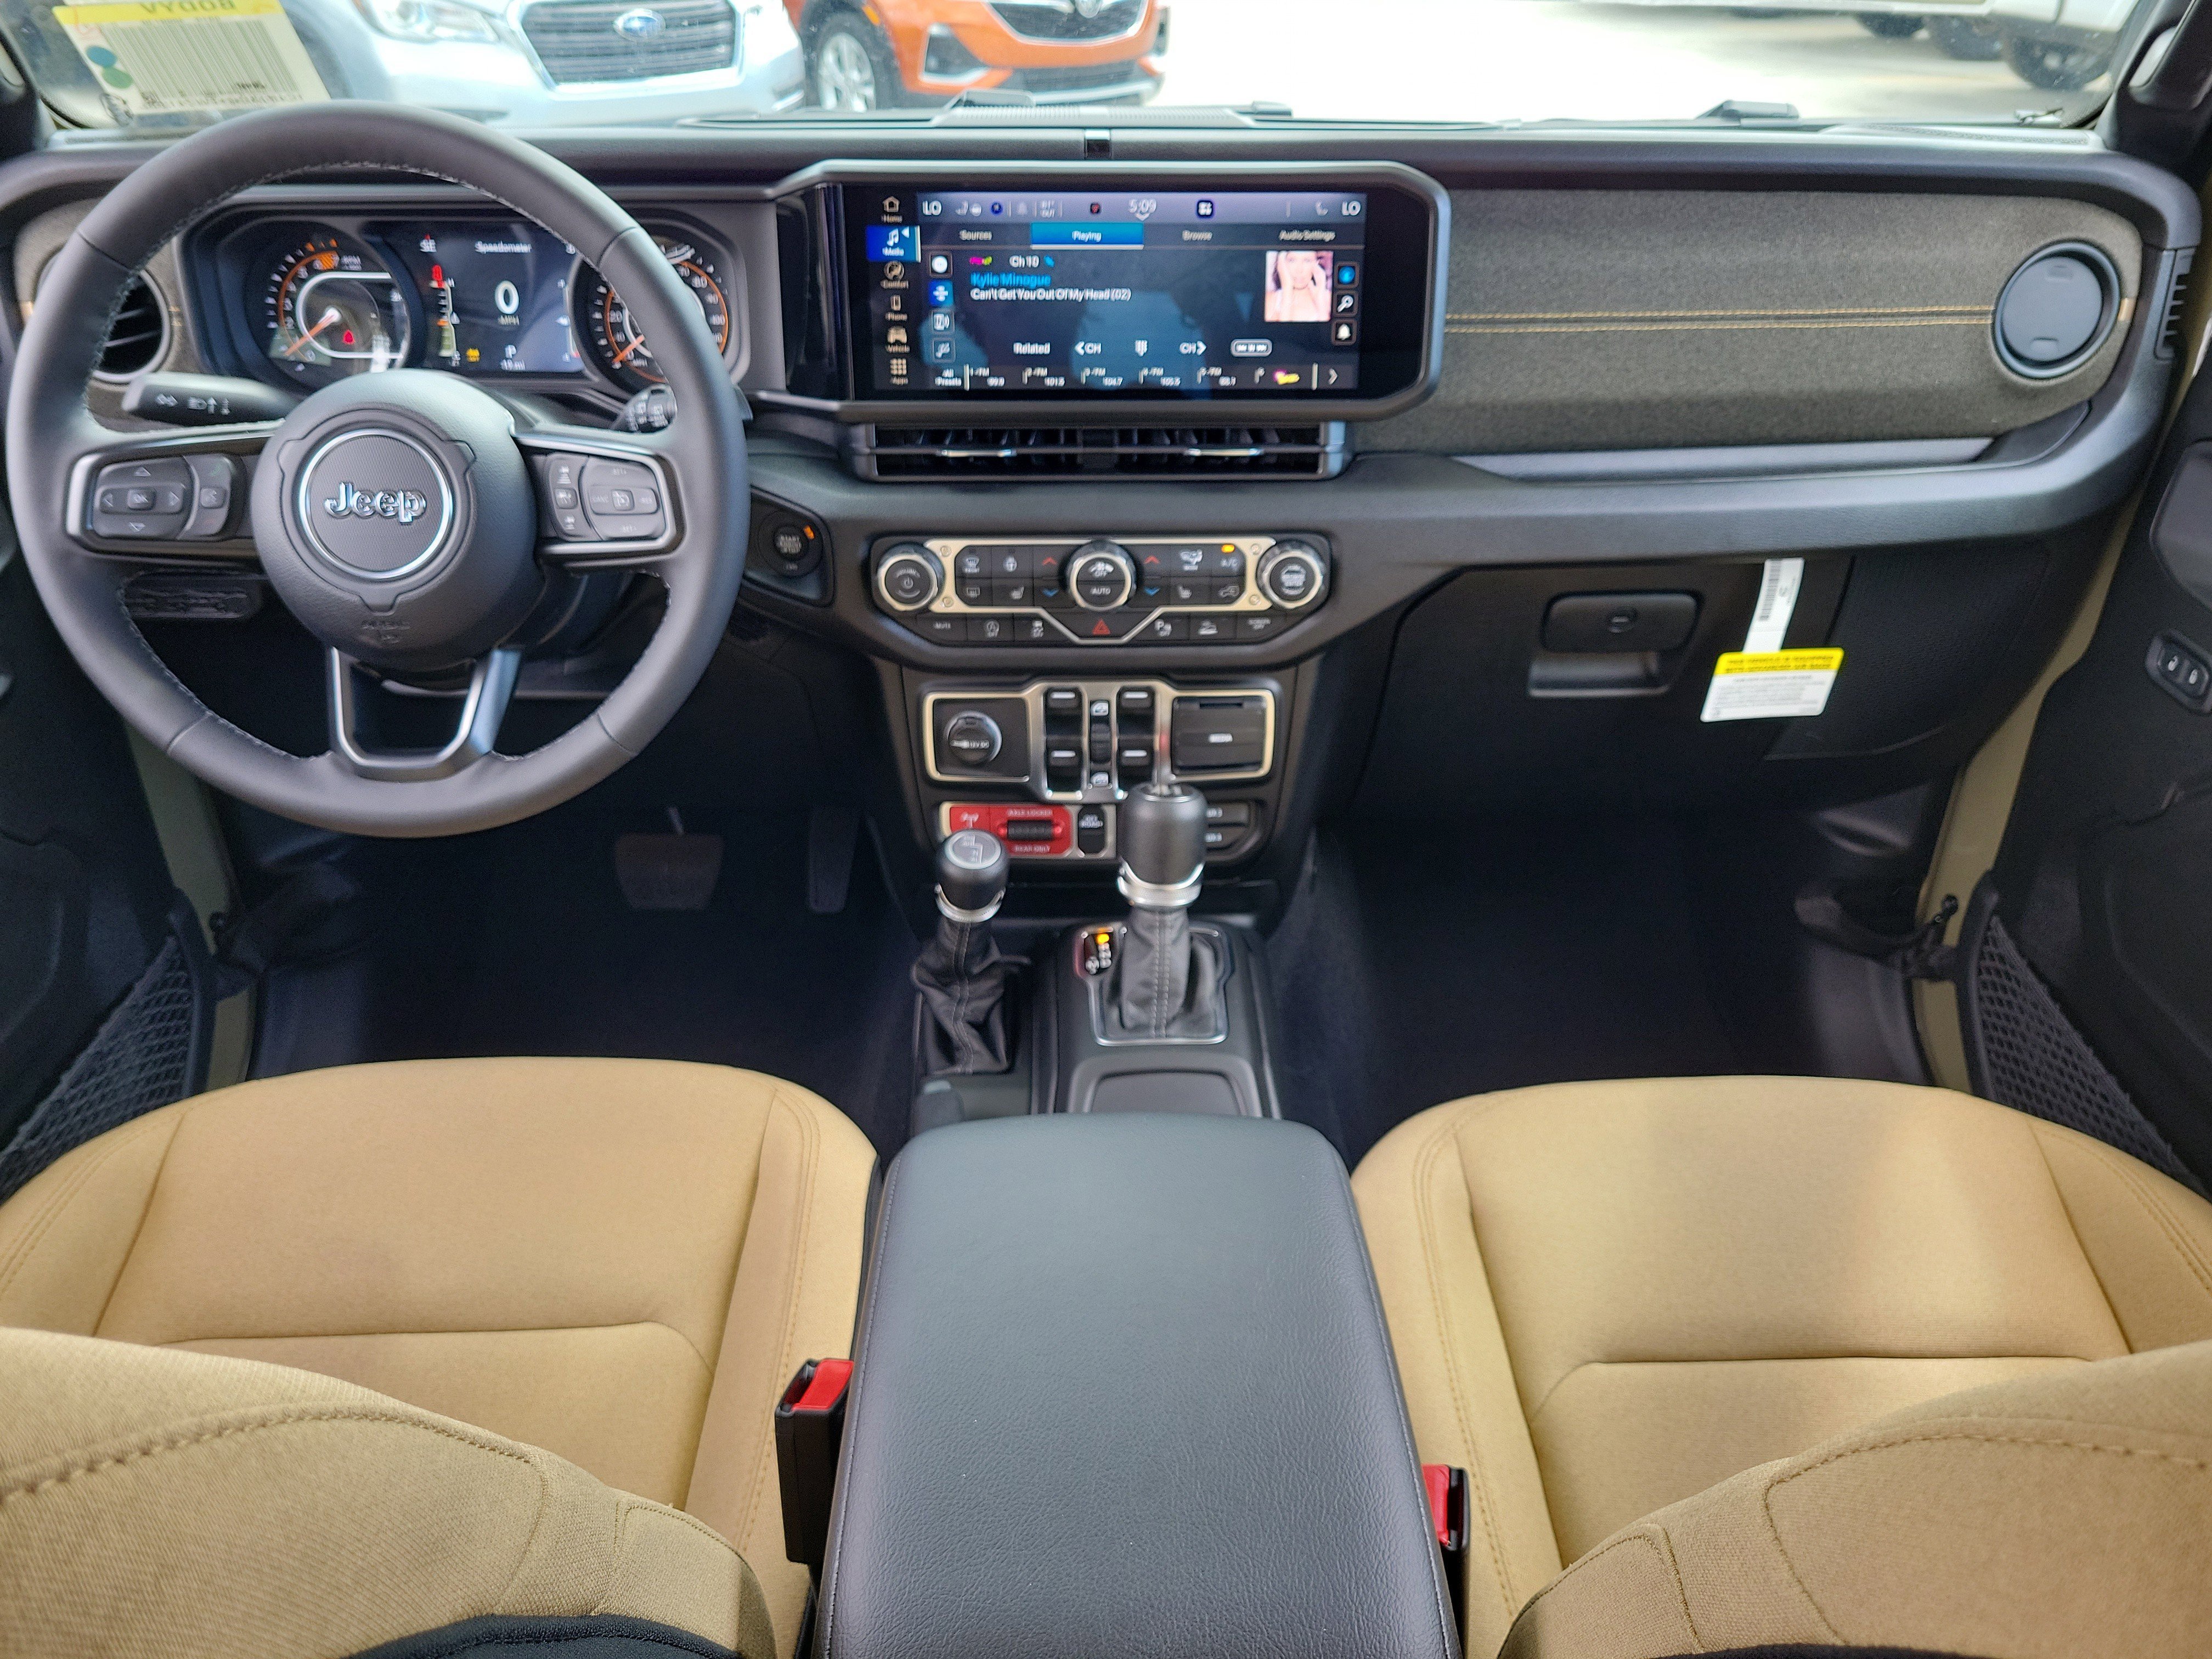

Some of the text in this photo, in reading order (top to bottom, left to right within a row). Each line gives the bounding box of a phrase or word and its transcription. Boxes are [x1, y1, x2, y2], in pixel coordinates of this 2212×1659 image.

[922, 200, 942, 215] LO
[1128, 199, 1157, 213] 5:09
[1341, 201, 1361, 216] LO
[1072, 230, 1102, 242] Playing
[1009, 255, 1026, 268] Ch
[970, 271, 1051, 289] Kylie Minogue
[970, 287, 1131, 302] Can't Get You Out Of My Head (02)
[1013, 342, 1050, 354] Related
[1084, 342, 1102, 354] CH
[1180, 342, 1197, 354] CH
[324, 481, 426, 523] Jeep
[1090, 587, 1111, 595] AUTO
